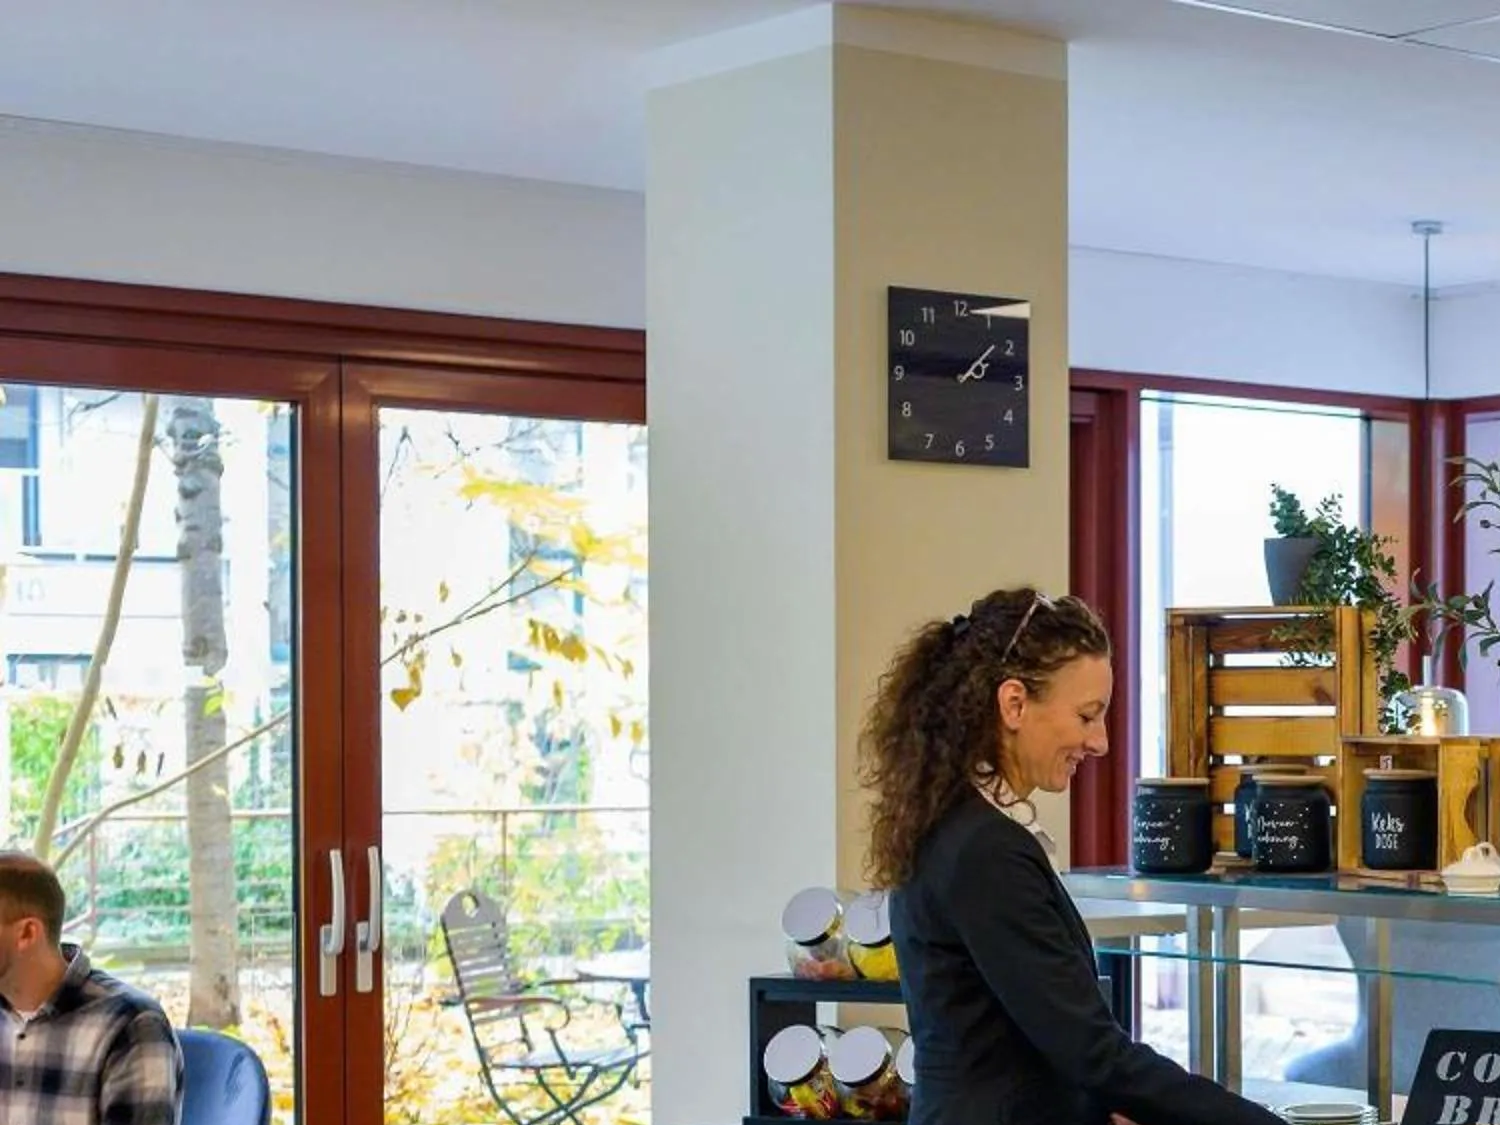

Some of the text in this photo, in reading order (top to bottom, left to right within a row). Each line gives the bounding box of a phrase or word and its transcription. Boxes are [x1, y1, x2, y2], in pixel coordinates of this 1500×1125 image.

[921, 307, 935, 324] 11
[954, 300, 969, 317] 12
[985, 312, 992, 330] 1
[900, 329, 915, 346] 10
[1004, 340, 1015, 356] 2
[894, 365, 904, 381] 9
[1014, 376, 1024, 391] 3
[902, 401, 911, 417] 8
[1003, 409, 1013, 424] 4
[924, 433, 934, 449] 7
[955, 440, 965, 457] 6
[984, 434, 994, 450] 5
